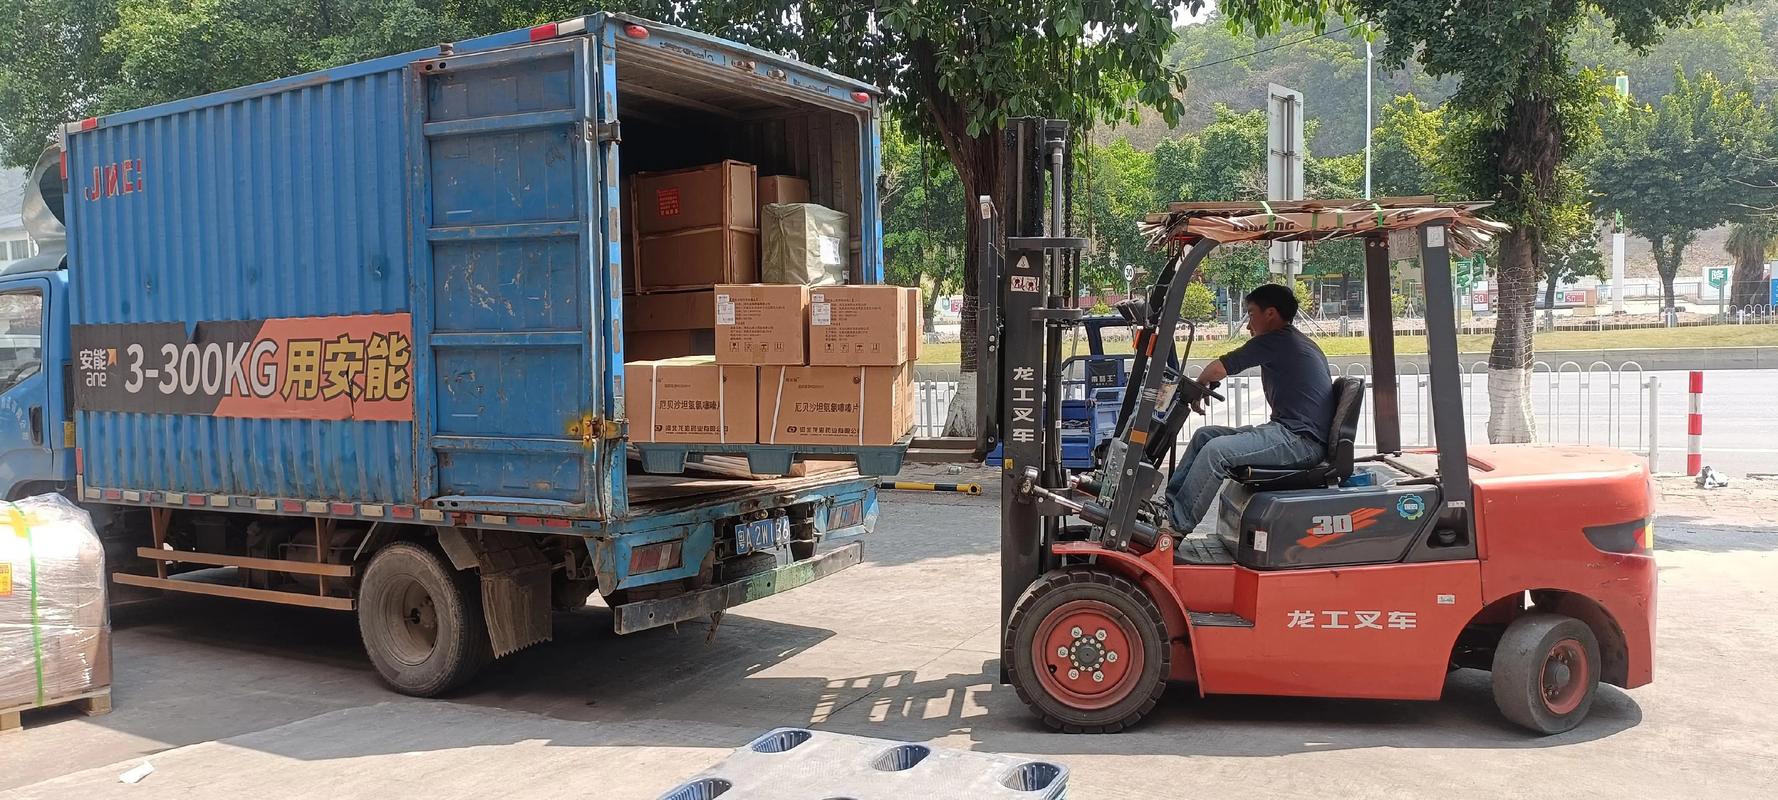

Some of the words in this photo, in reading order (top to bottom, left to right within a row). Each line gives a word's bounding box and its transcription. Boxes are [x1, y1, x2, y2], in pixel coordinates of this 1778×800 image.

[80, 348, 107, 370] 安能
[125, 340, 279, 397] 3-300KG
[280, 331, 411, 402] 用安能
[86, 371, 107, 387] ane
[1012, 366, 1035, 443] 龙工叉车
[1312, 514, 1353, 535] 30
[1287, 610, 1417, 630] 龙工叉车
